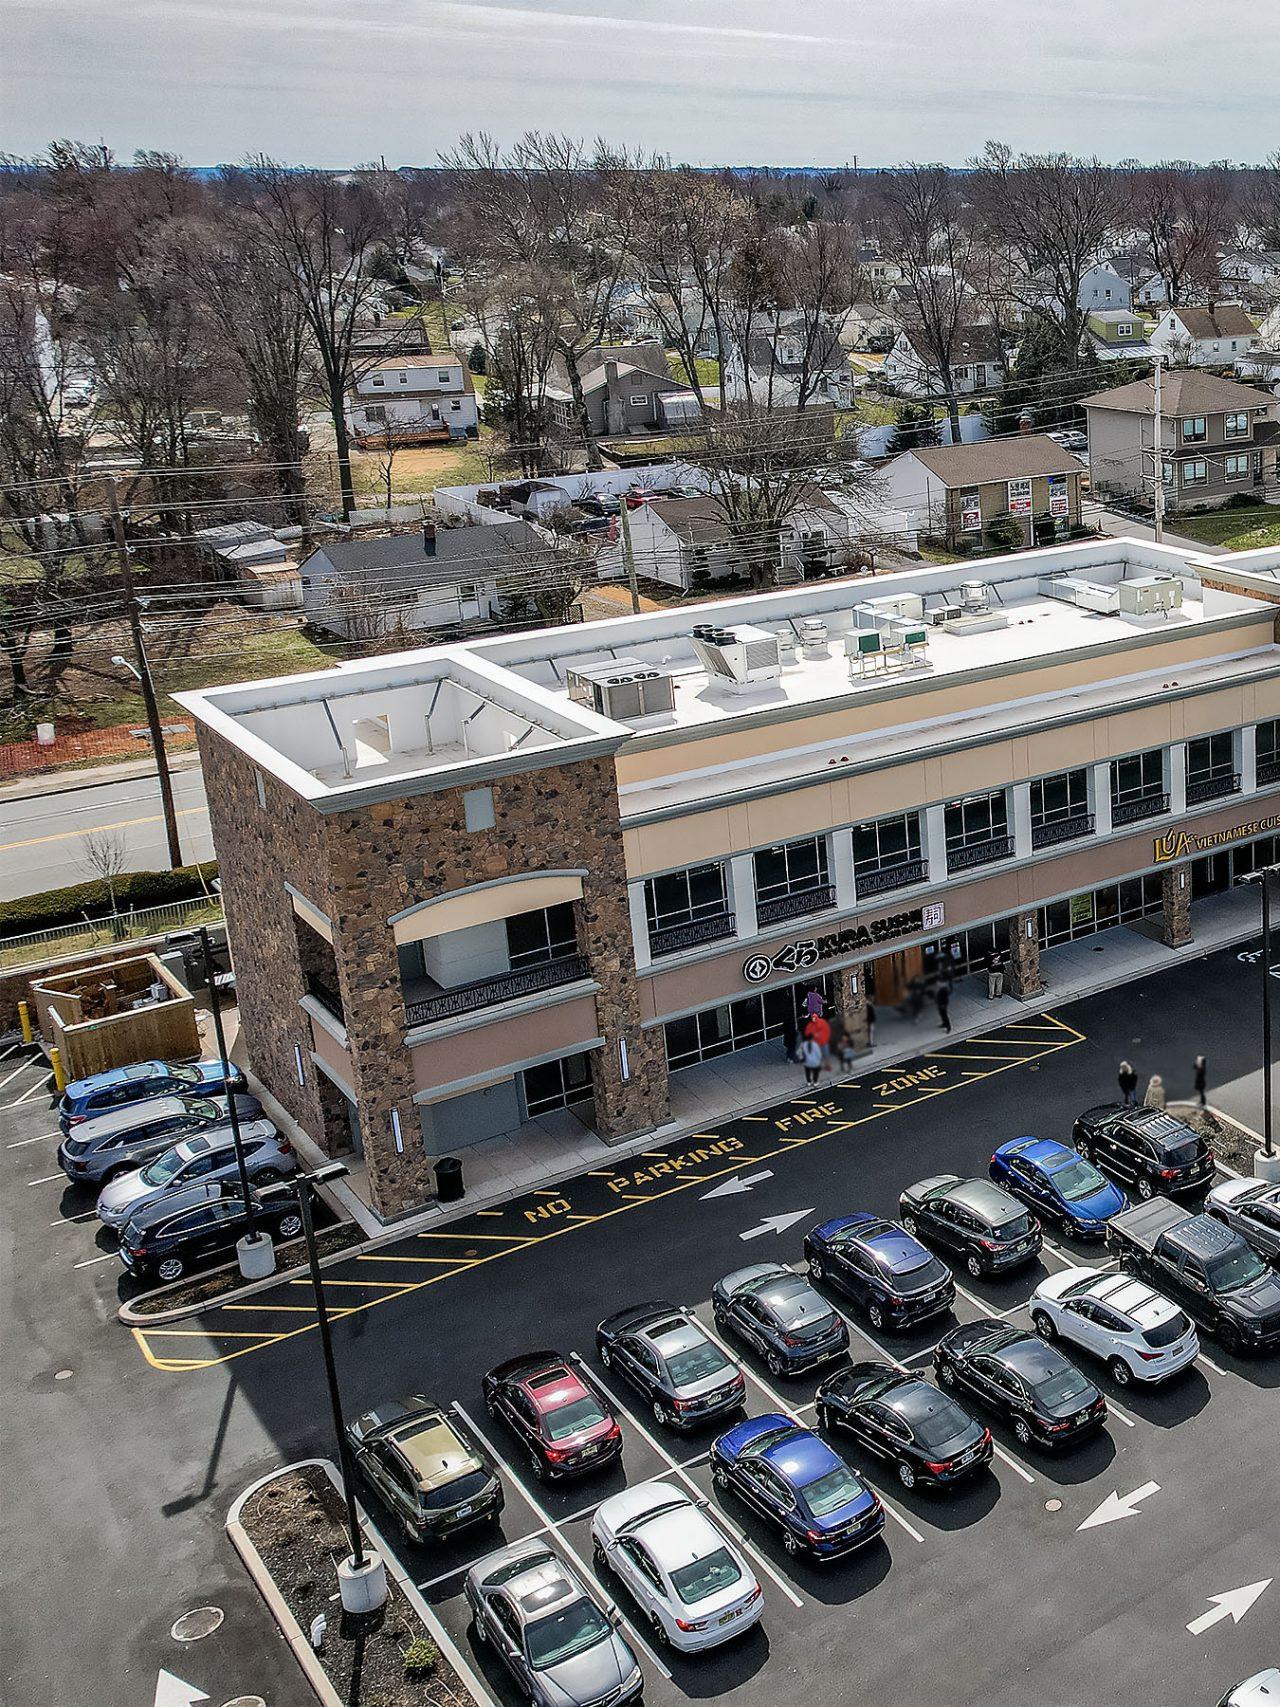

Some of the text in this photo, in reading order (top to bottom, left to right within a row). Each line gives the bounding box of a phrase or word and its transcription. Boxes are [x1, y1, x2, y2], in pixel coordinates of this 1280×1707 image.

[1196, 822, 1258, 849] VIETNAMESE
[816, 907, 922, 950] KURA SUSHI
[523, 1064, 946, 1223] NO PARKING FIRE ZONE
